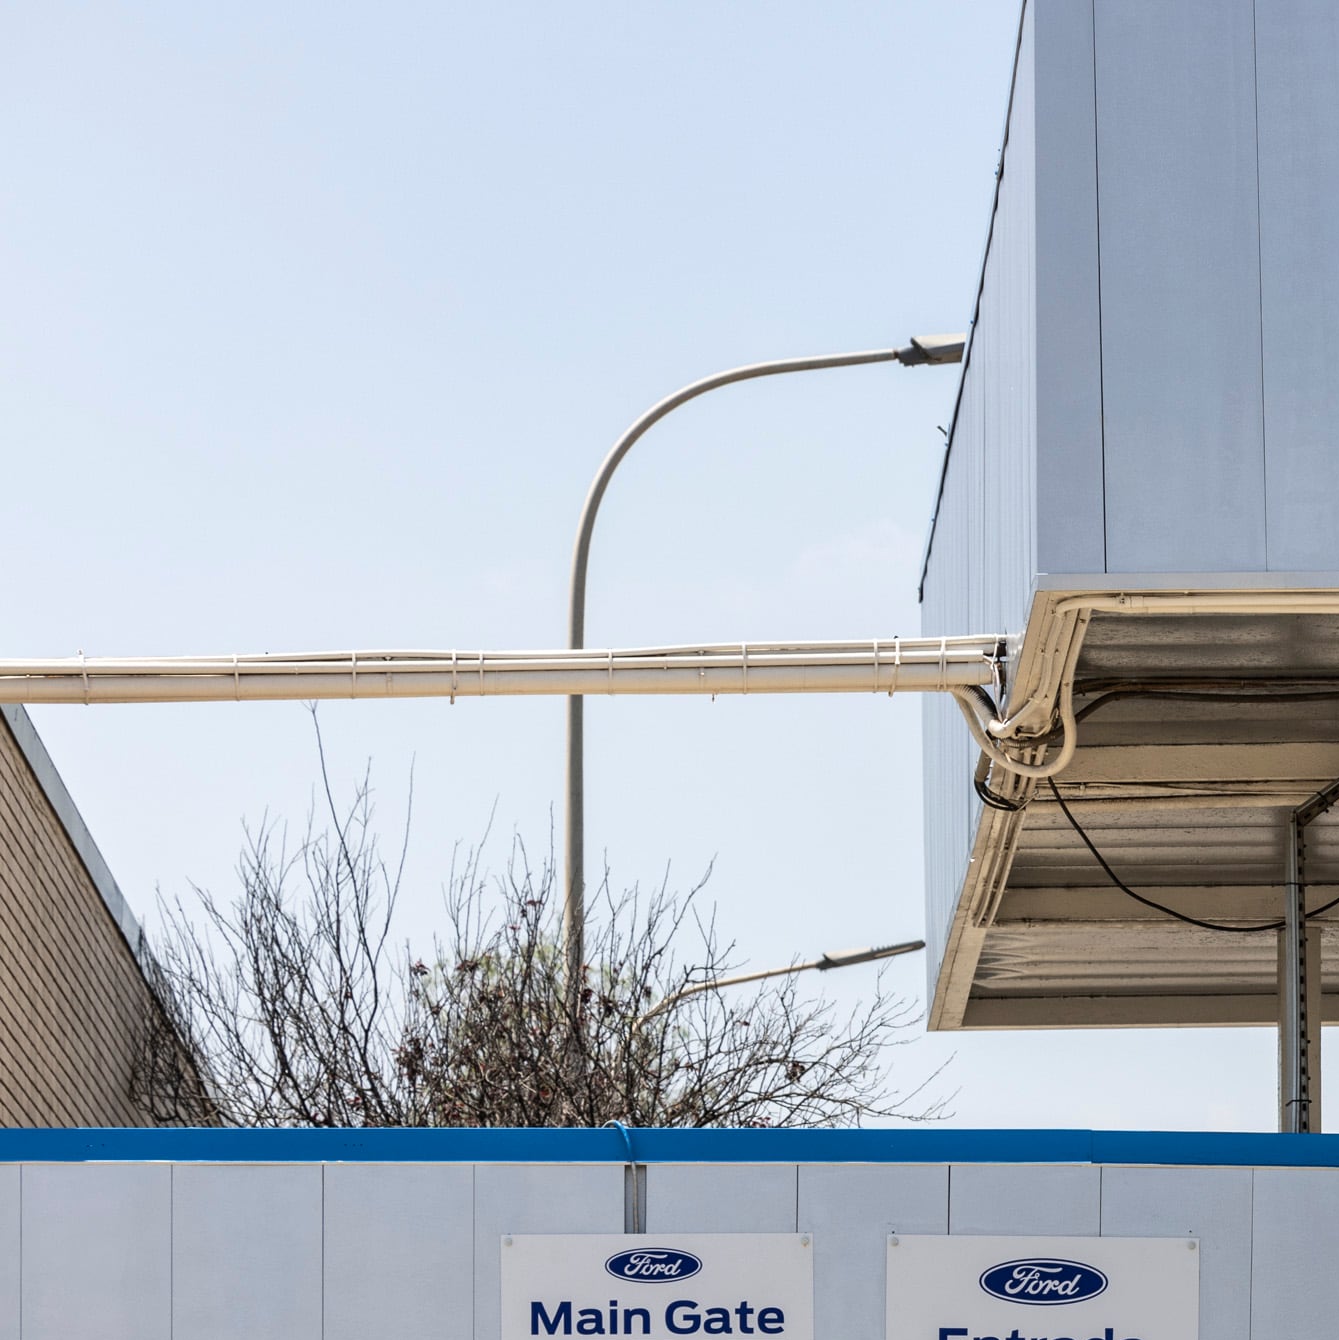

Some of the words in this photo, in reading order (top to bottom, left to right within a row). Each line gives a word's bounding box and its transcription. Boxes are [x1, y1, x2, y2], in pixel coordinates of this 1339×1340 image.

[624, 1253, 682, 1276] Ford
[1004, 1265, 1082, 1295] Ford
[530, 1299, 650, 1335] Main
[664, 1299, 784, 1335] Gate
